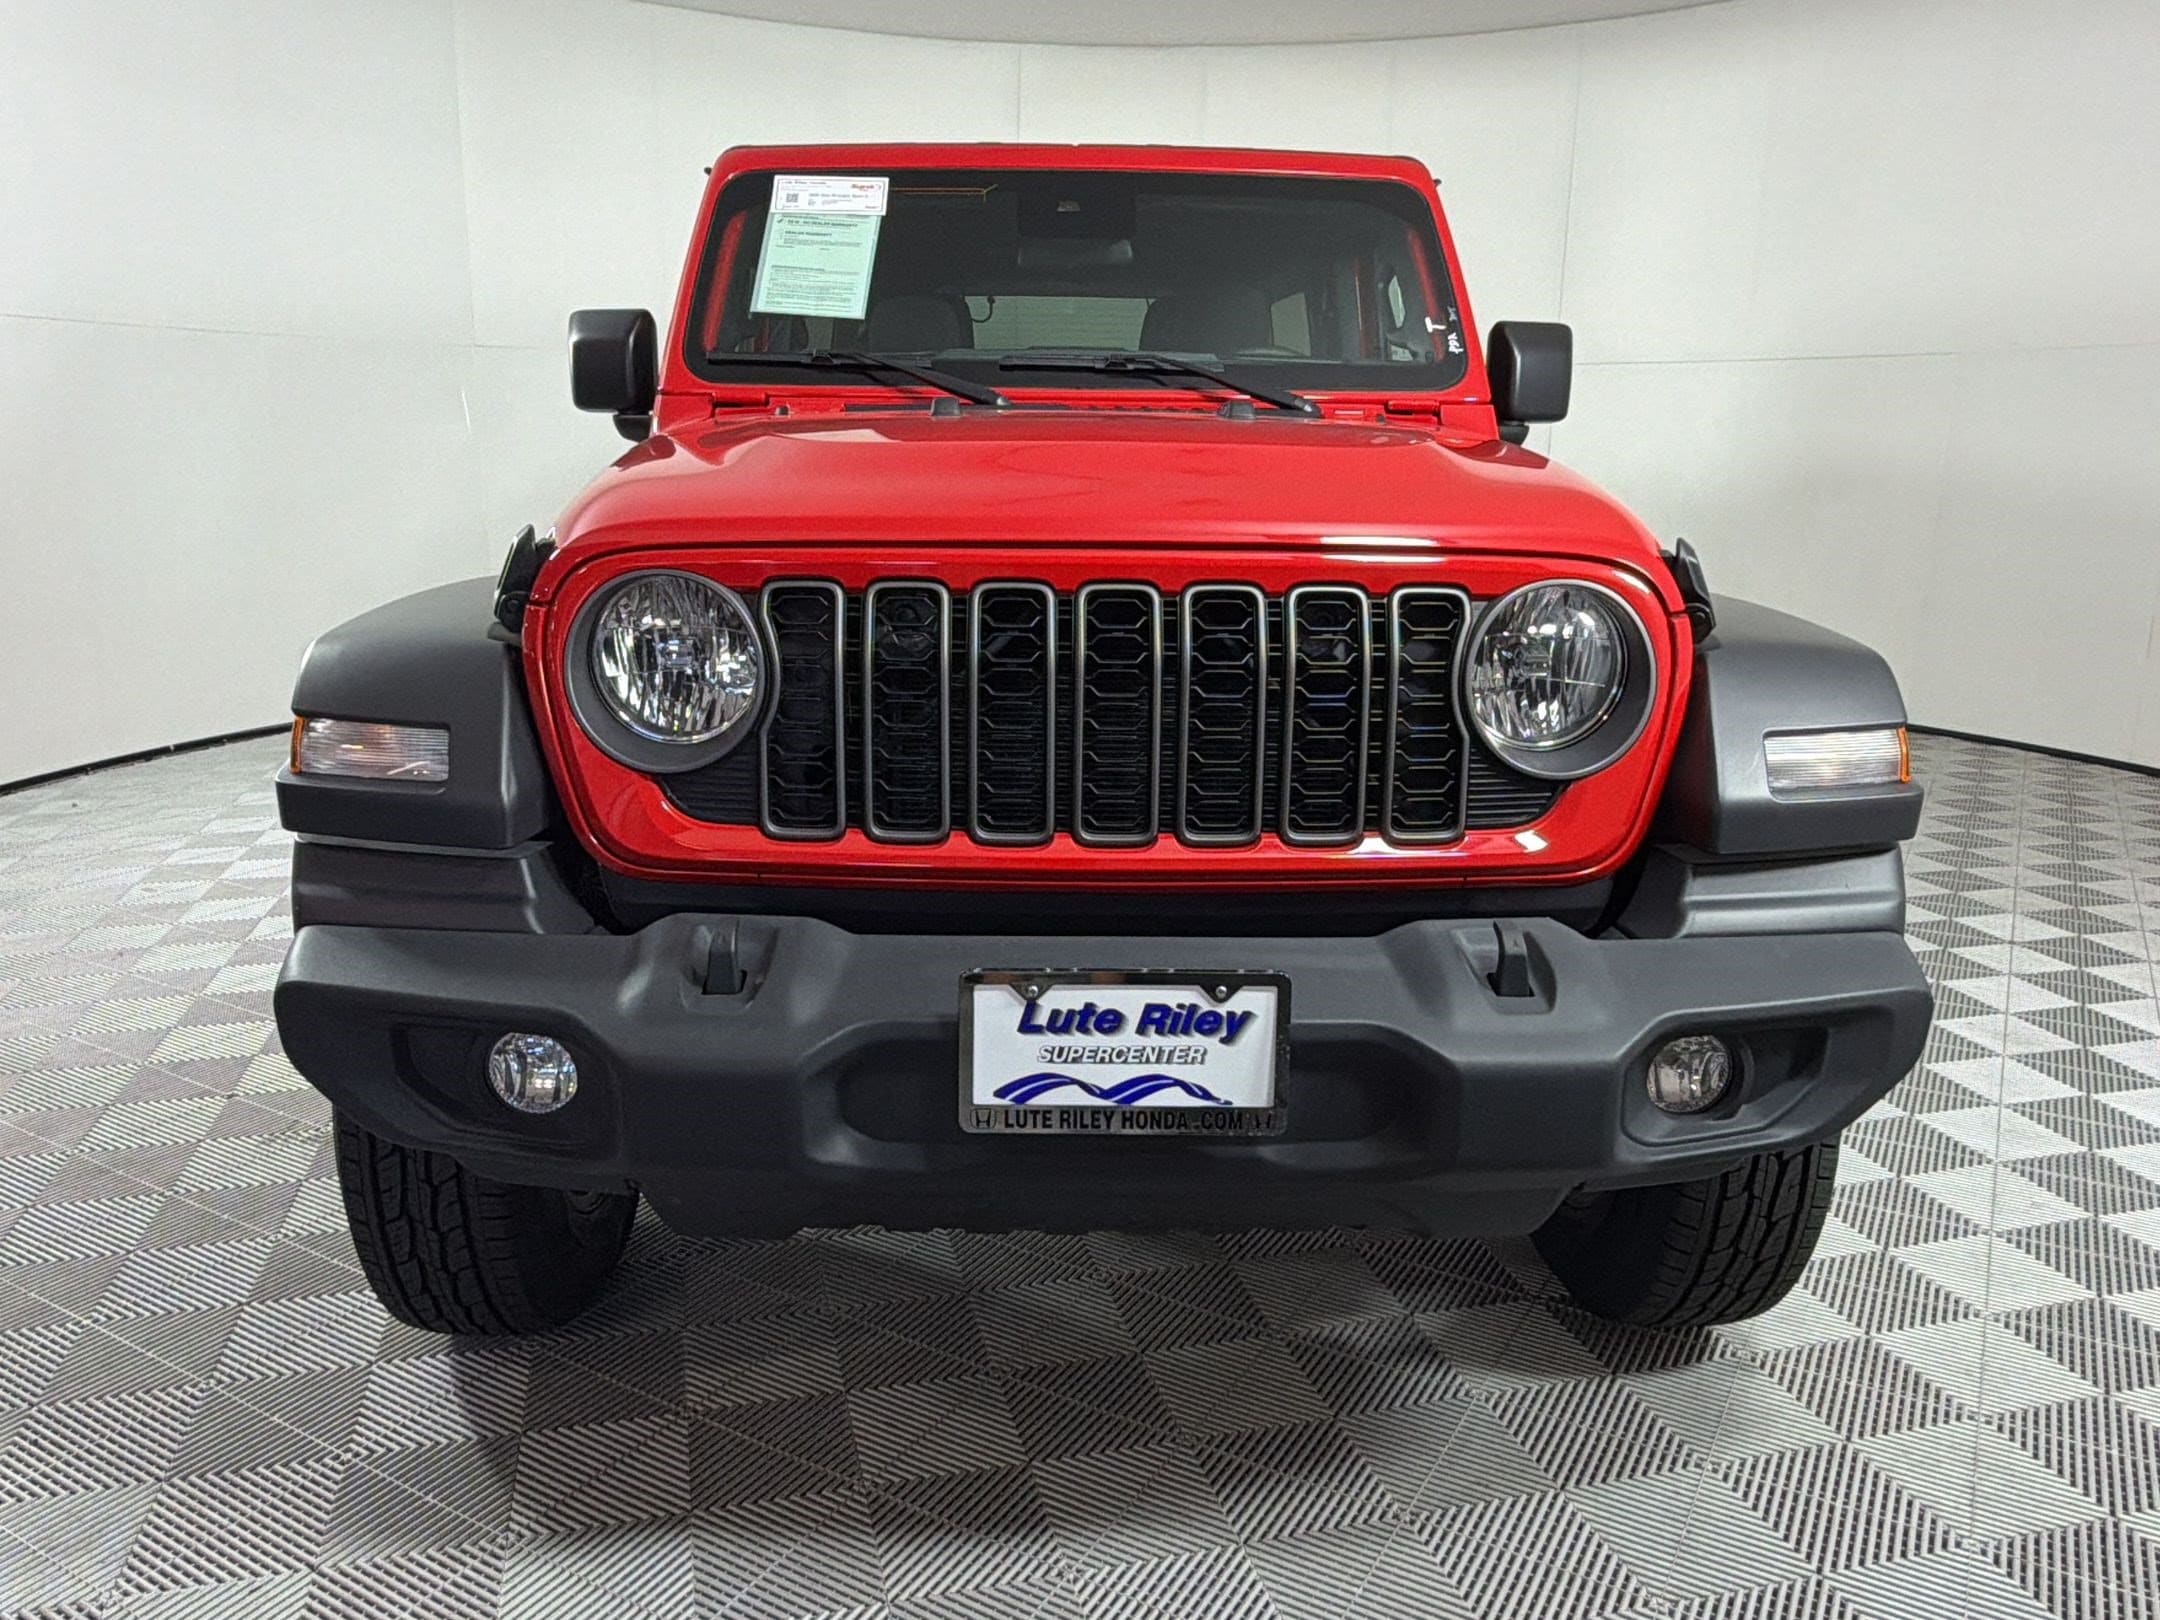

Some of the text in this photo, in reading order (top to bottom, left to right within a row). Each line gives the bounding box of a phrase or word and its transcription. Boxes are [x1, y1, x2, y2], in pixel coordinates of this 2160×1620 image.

[1017, 1000, 1257, 1044] Lute Riley
[1037, 1045, 1208, 1066] SUPERCENTER
[1004, 1110, 1055, 1129] LUTE
[1059, 1110, 1115, 1129] RILEY
[1121, 1110, 1188, 1129] HONDA
